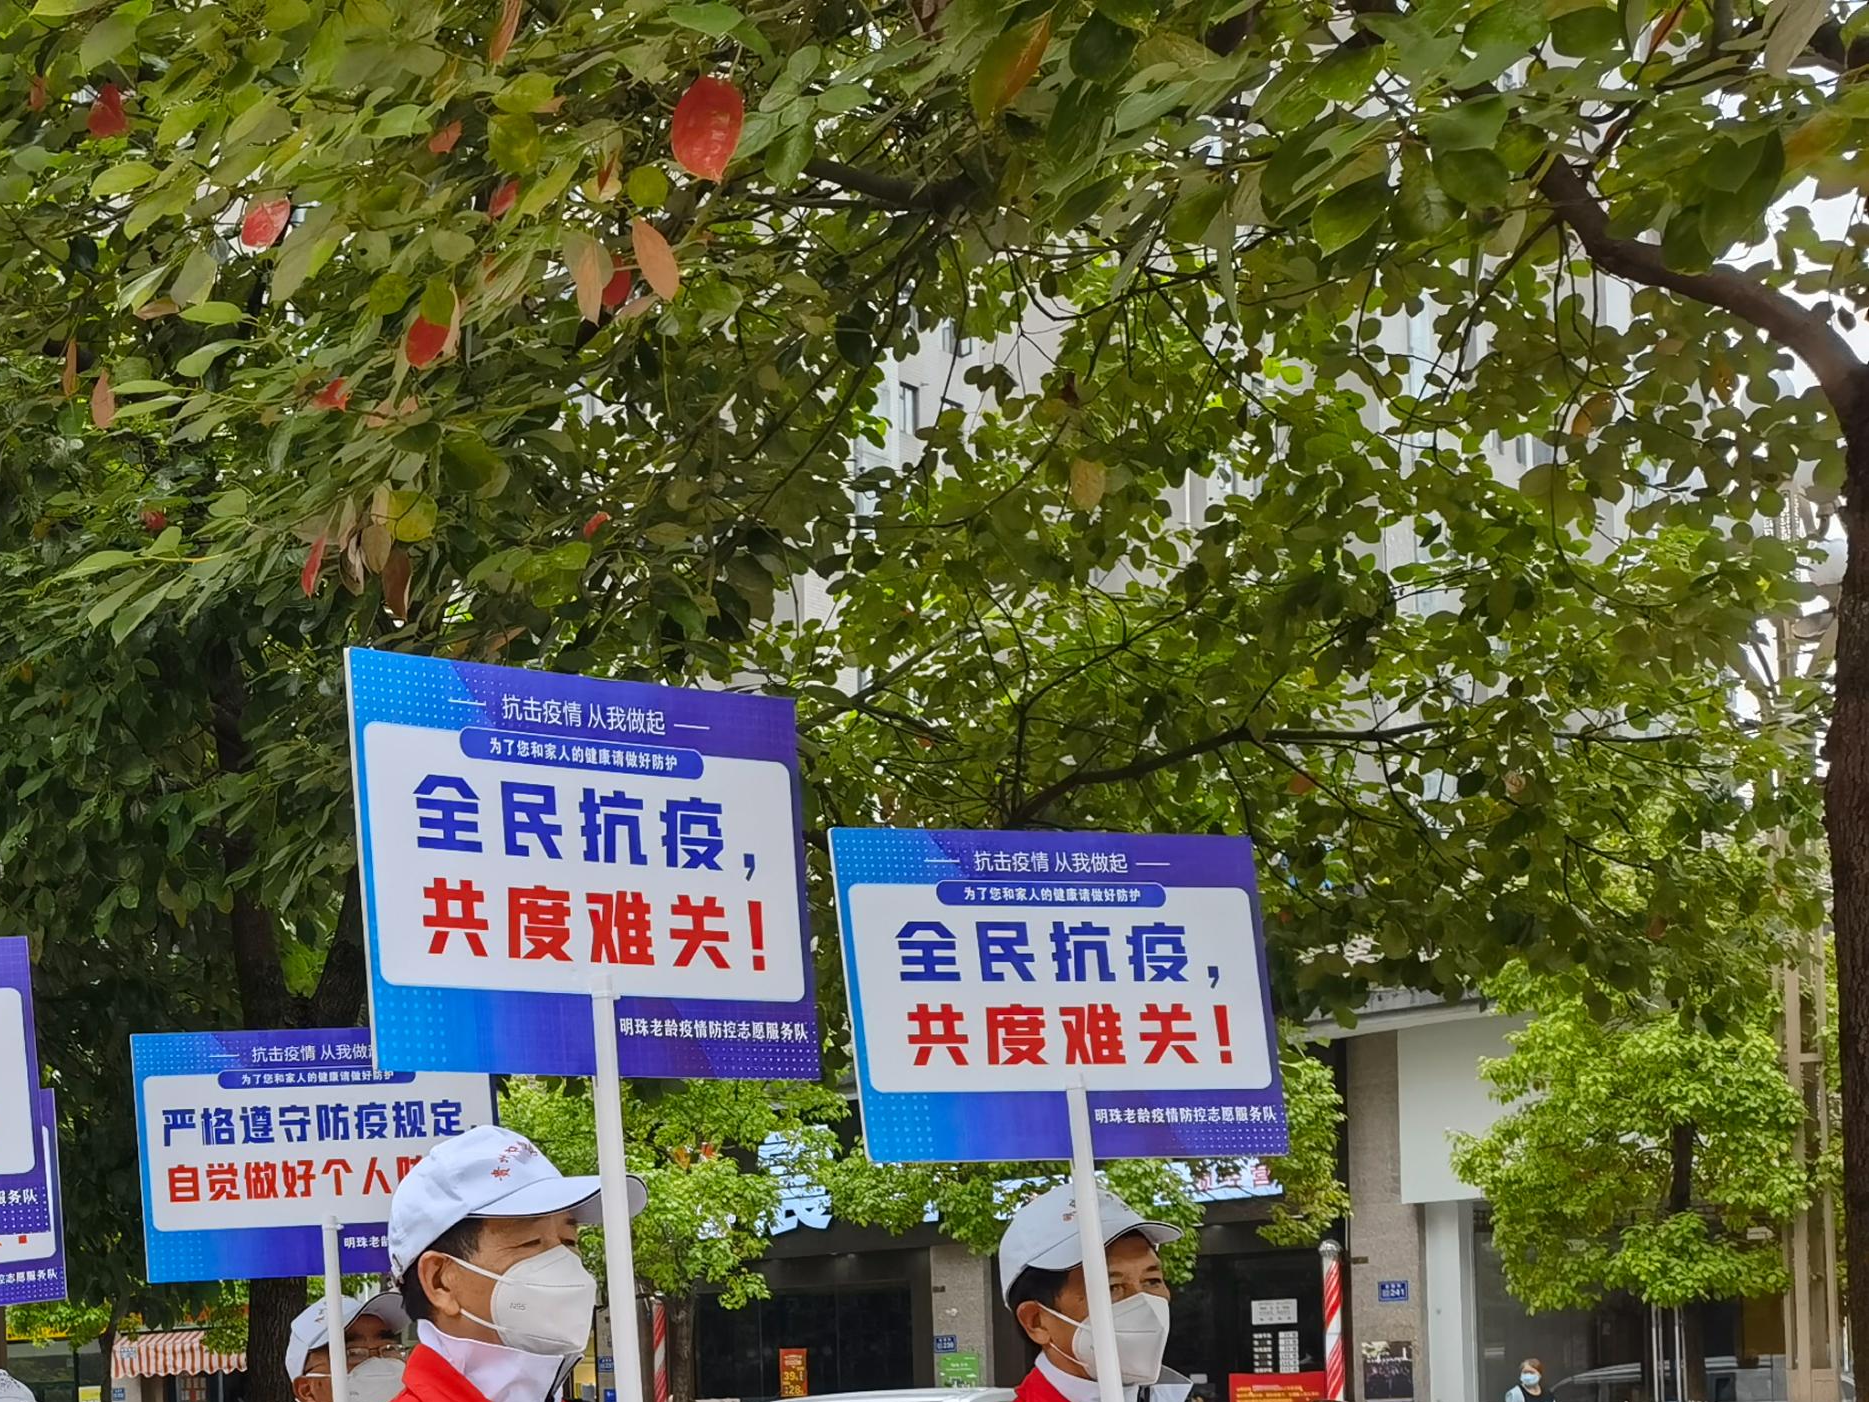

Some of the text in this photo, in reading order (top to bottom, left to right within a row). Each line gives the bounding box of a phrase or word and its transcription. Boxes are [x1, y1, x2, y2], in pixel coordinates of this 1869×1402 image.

[501, 693, 666, 736] 抗击疫情 从我做起
[489, 737, 679, 772] 为了您和家人的健康请做好防护
[973, 851, 1129, 875] 抗击疫情 从我做起
[963, 886, 1142, 904] 为了您和家人的健康请做好防护
[422, 877, 766, 971] 共度难关！
[619, 1017, 809, 1041] 明珠老龄疫情防控志愿服务队
[907, 1003, 1234, 1066] 共度难关！
[251, 1043, 373, 1064] 抗击疫情 从我做
[1094, 1105, 1278, 1125] 明珠老龄疫情防控志愿服务队
